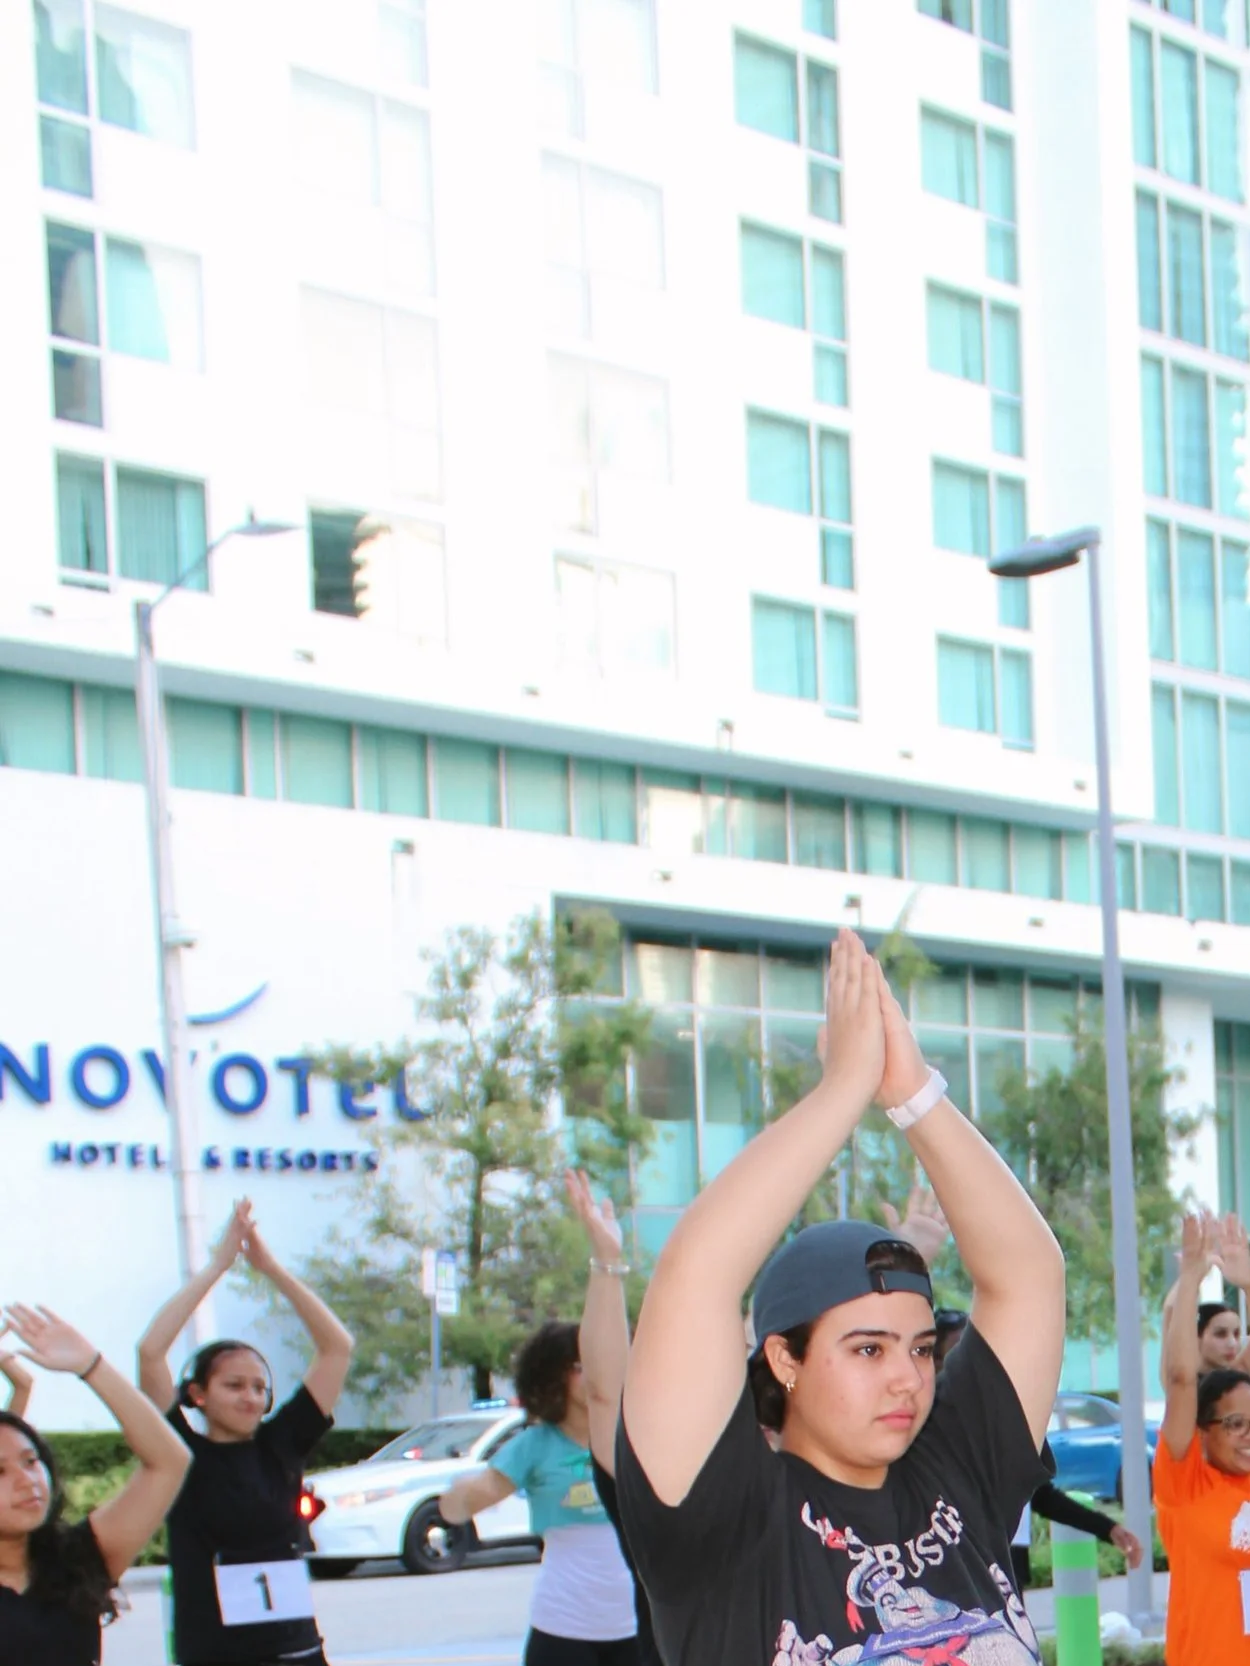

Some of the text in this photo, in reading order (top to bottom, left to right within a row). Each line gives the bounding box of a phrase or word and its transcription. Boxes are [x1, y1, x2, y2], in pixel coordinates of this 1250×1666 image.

[51, 1141, 380, 1173] HOTEL & RESORTS
[254, 1570, 274, 1612] 1
